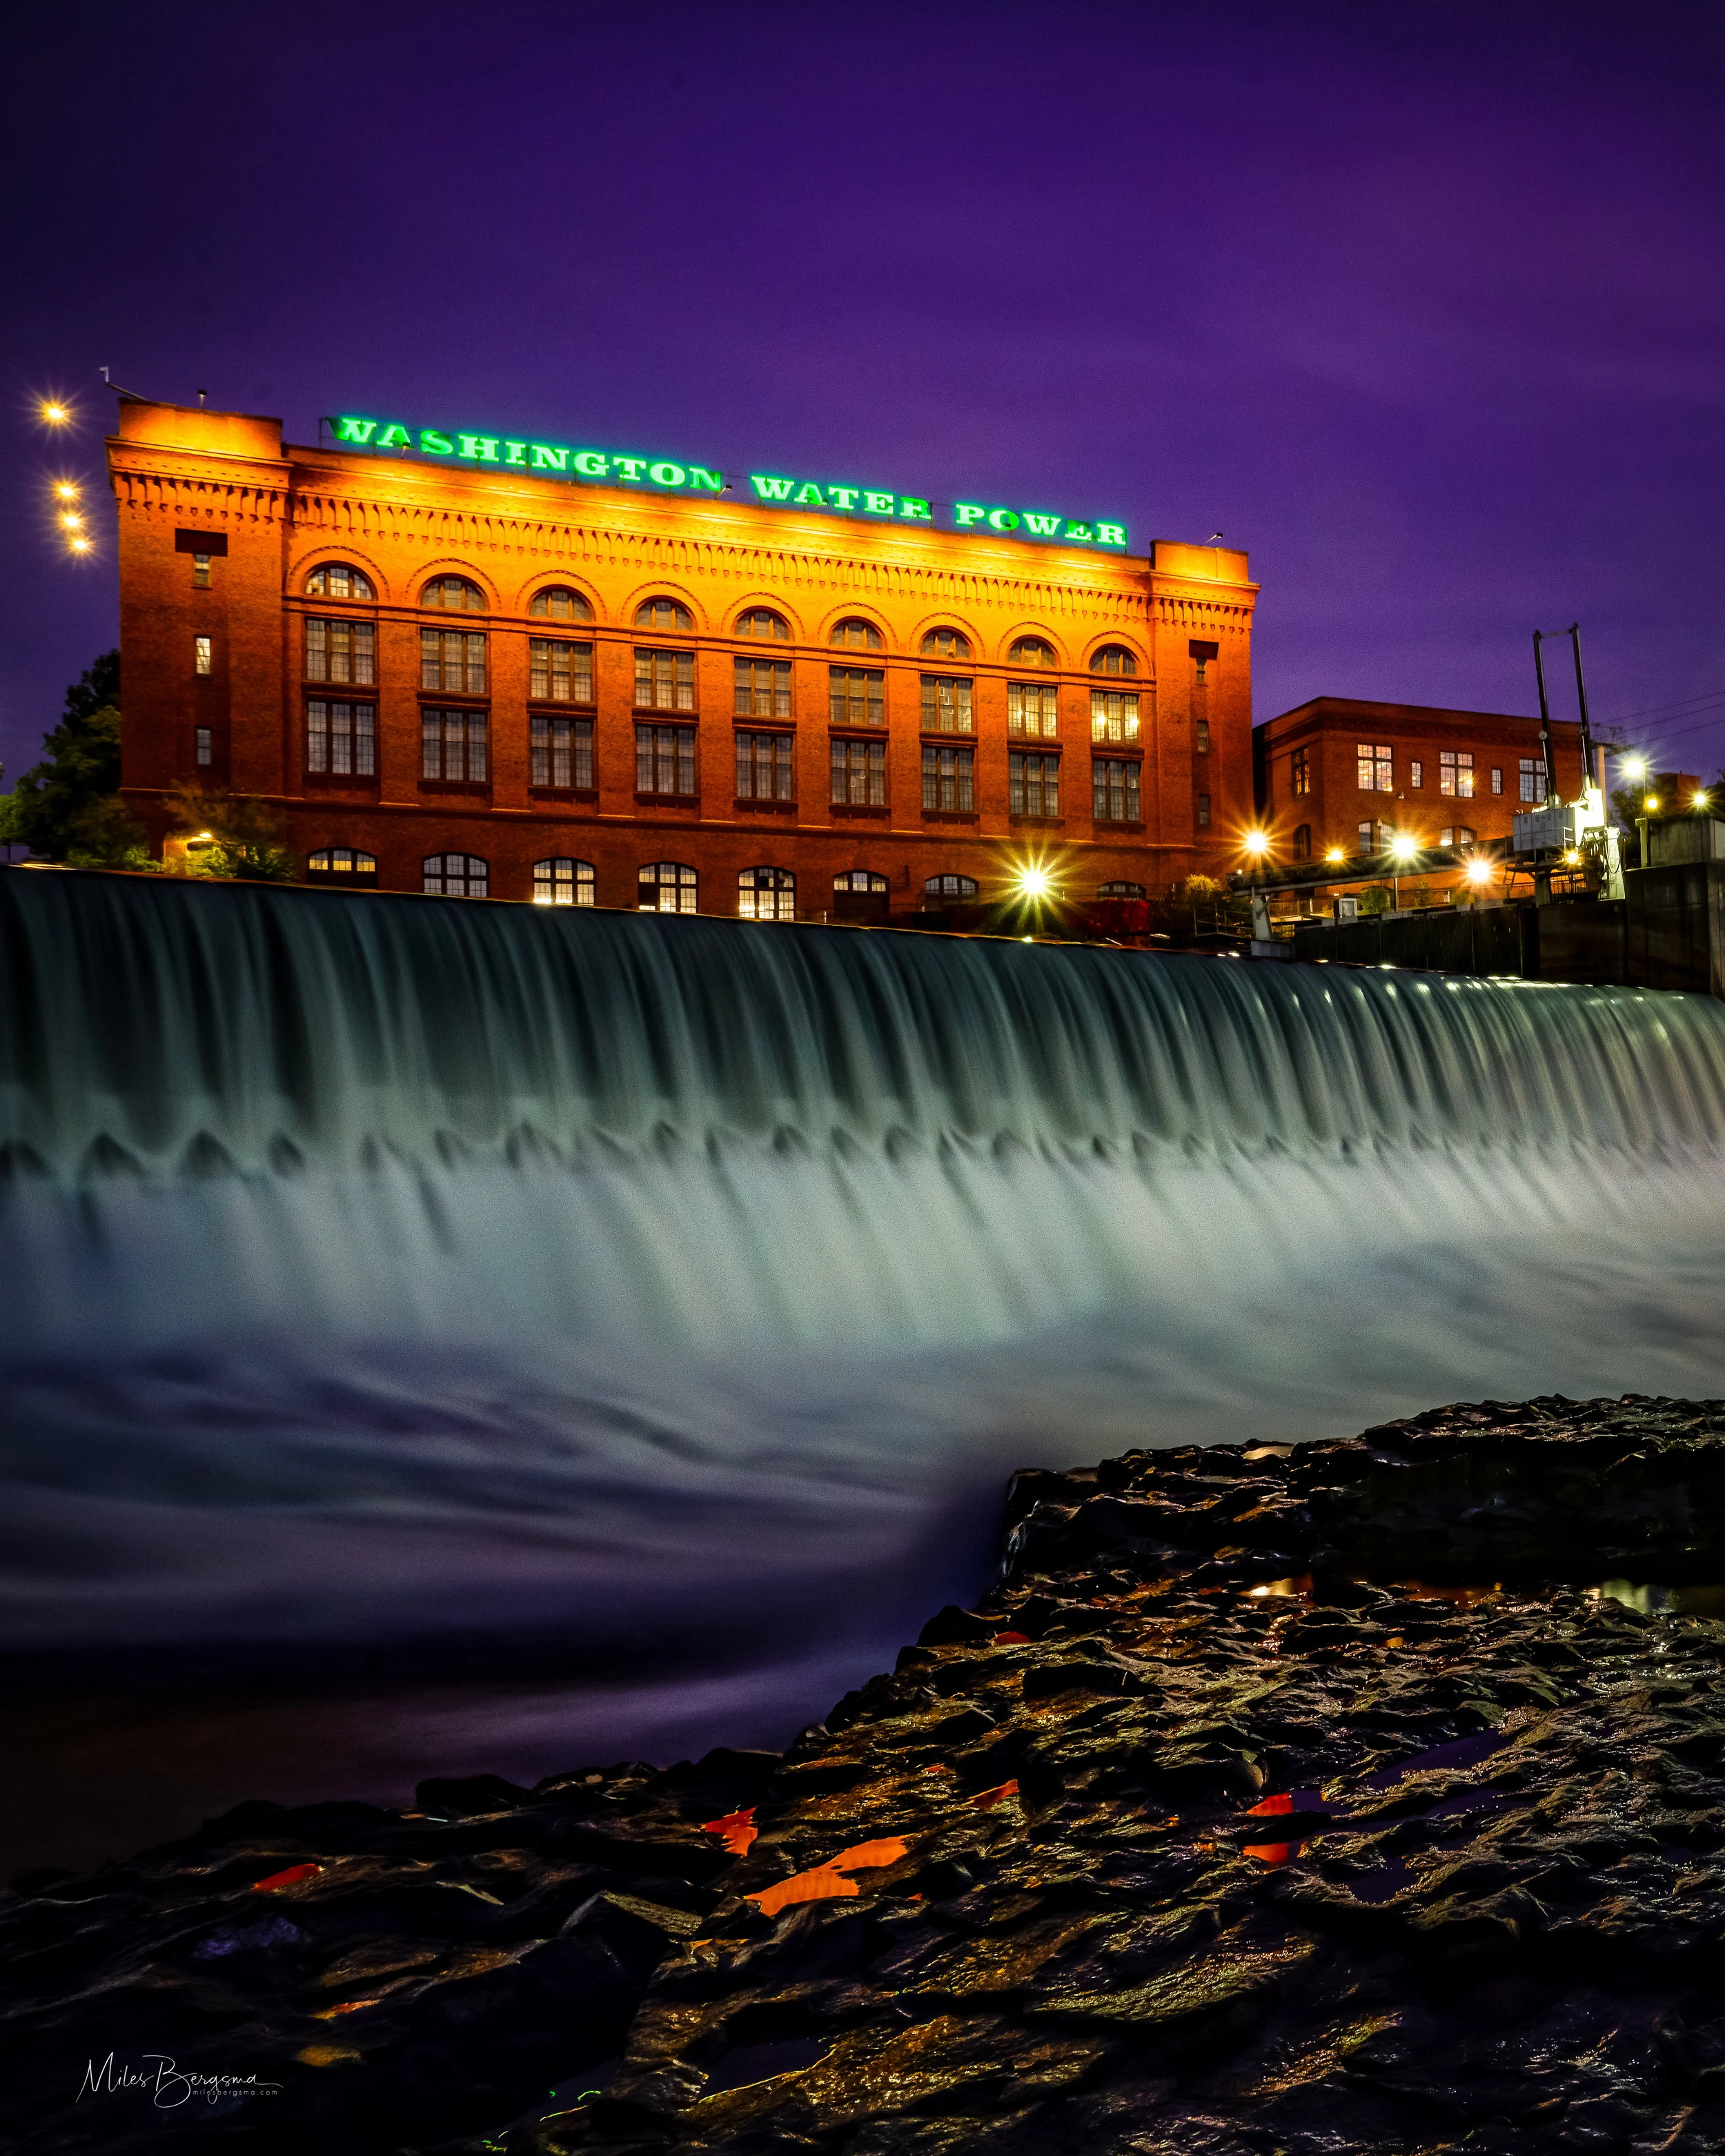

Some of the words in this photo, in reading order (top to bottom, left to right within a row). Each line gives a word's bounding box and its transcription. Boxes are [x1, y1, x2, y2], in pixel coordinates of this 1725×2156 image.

[328, 416, 723, 492] WASHINGTON
[751, 475, 932, 520] WATER
[955, 503, 1127, 546] POWER
